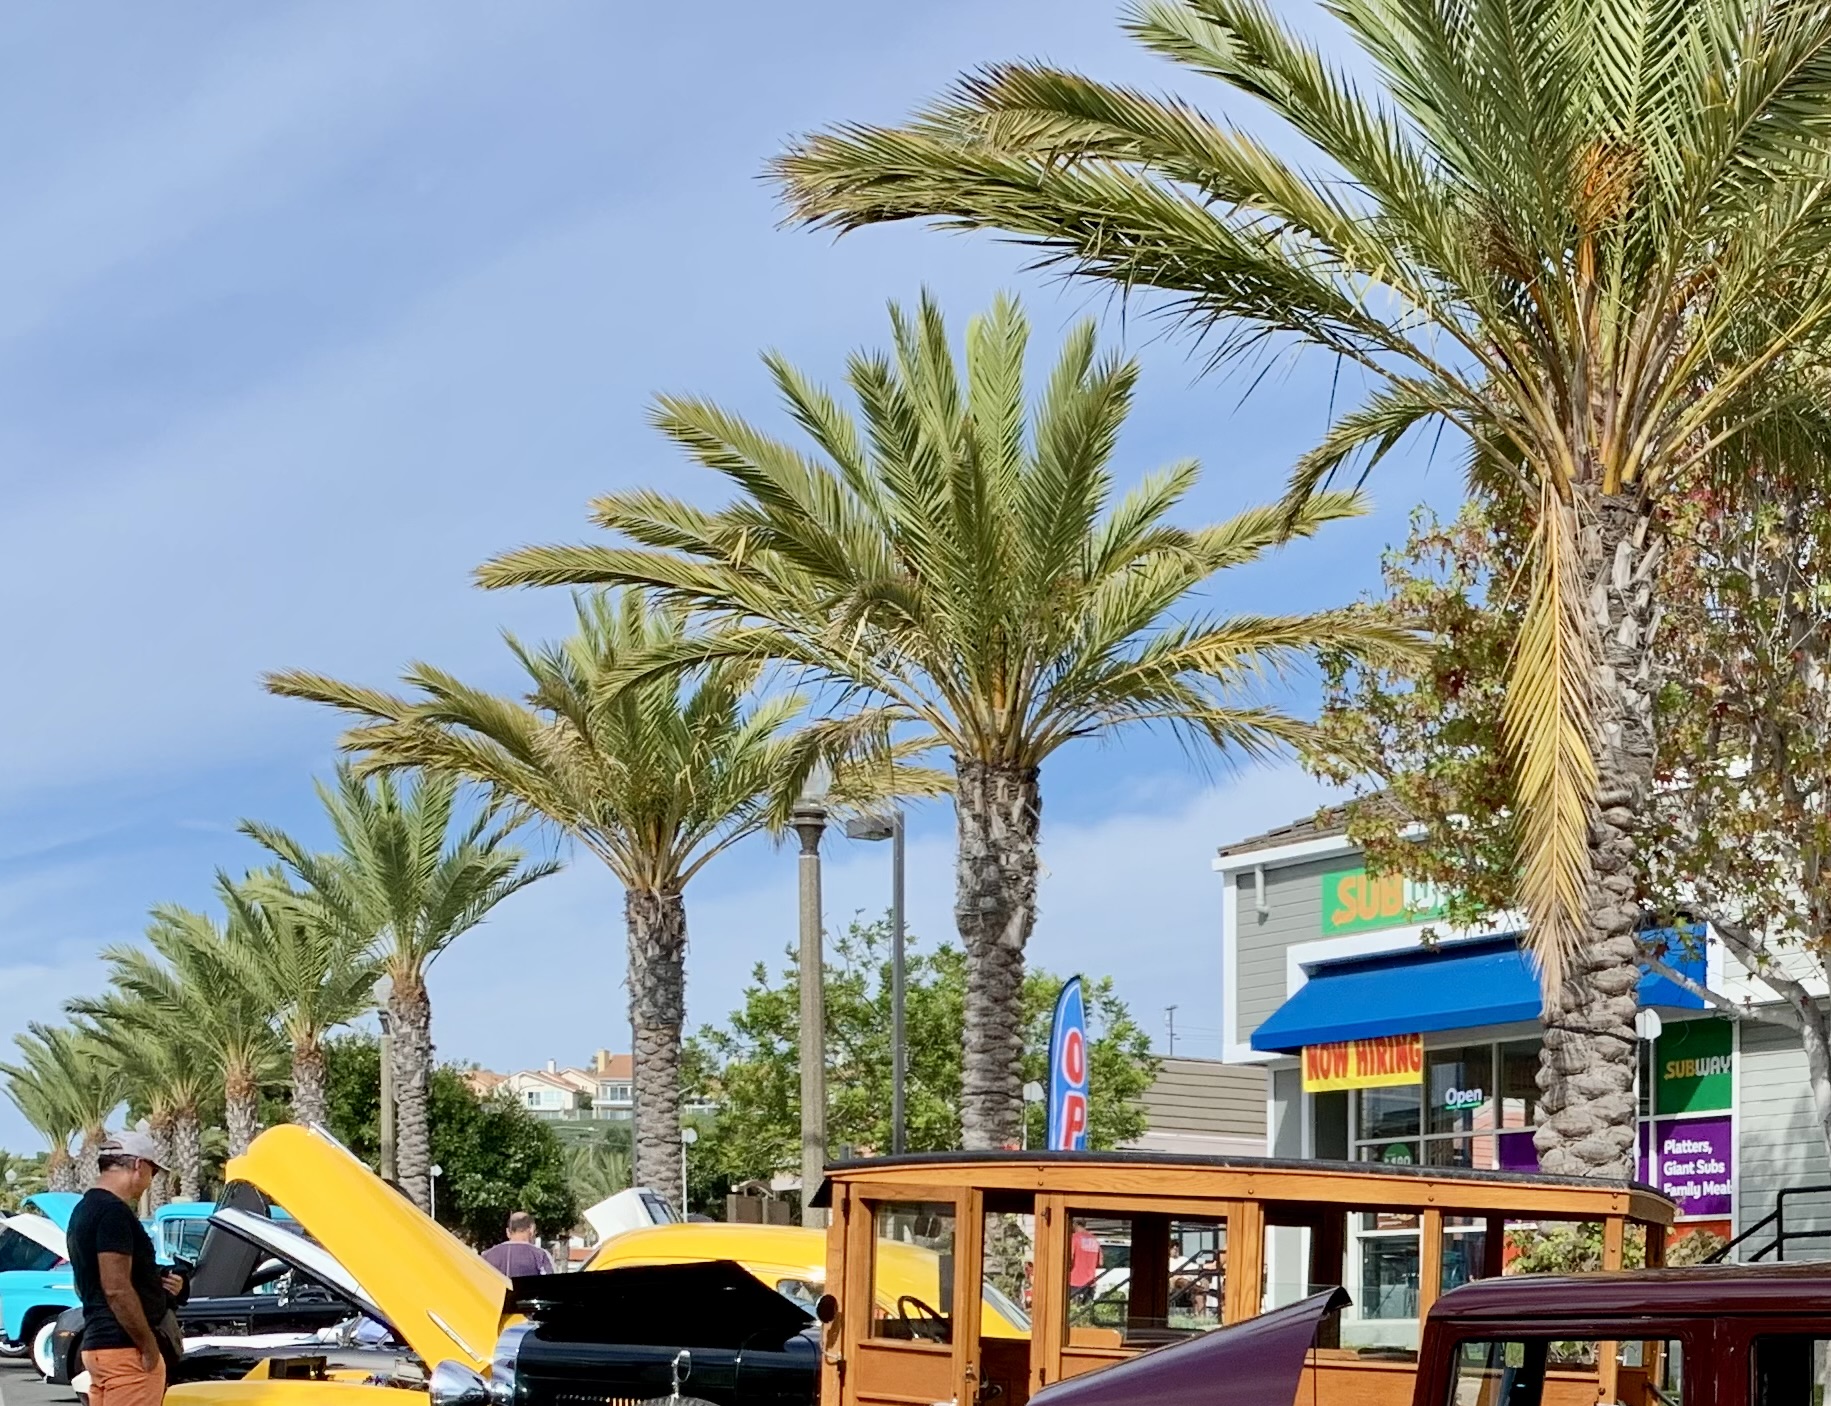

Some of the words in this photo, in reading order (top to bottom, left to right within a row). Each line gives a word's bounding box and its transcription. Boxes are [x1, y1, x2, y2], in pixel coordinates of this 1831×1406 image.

[1332, 873, 1446, 926] SUBW
[1306, 1041, 1349, 1081] NOW
[1354, 1033, 1422, 1077] HIRING
[1664, 1055, 1732, 1080] SUBWAY
[1445, 1087, 1482, 1108] Open
[1664, 1139, 1713, 1155] Platters,
[1664, 1160, 1695, 1176] Giant
[1696, 1158, 1726, 1174] Subs
[1664, 1180, 1702, 1199] Family
